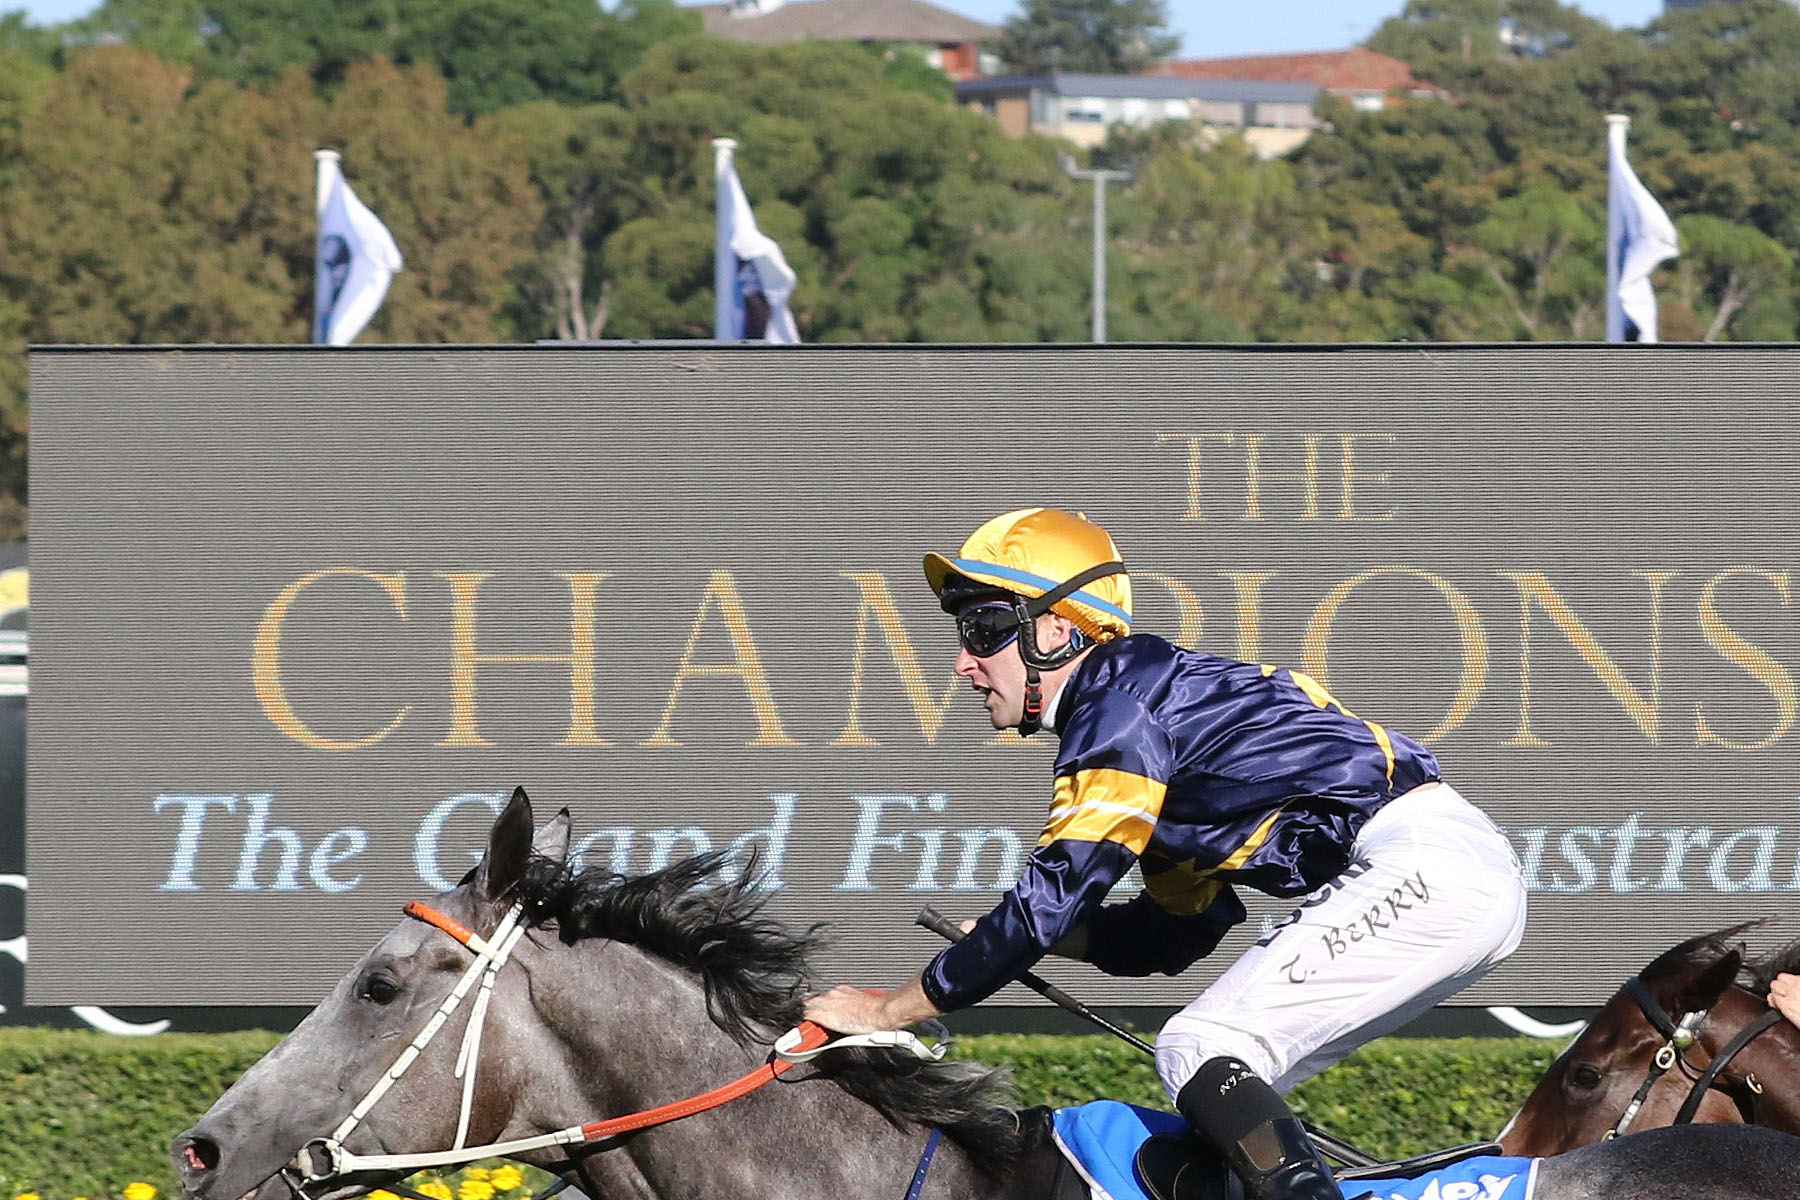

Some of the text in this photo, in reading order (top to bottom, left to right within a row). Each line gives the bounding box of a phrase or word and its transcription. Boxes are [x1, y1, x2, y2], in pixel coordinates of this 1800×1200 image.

[1155, 432, 1398, 522] THE
[152, 792, 370, 892] The
[412, 790, 800, 892] Gand
[1320, 869, 1431, 961] BERRY
